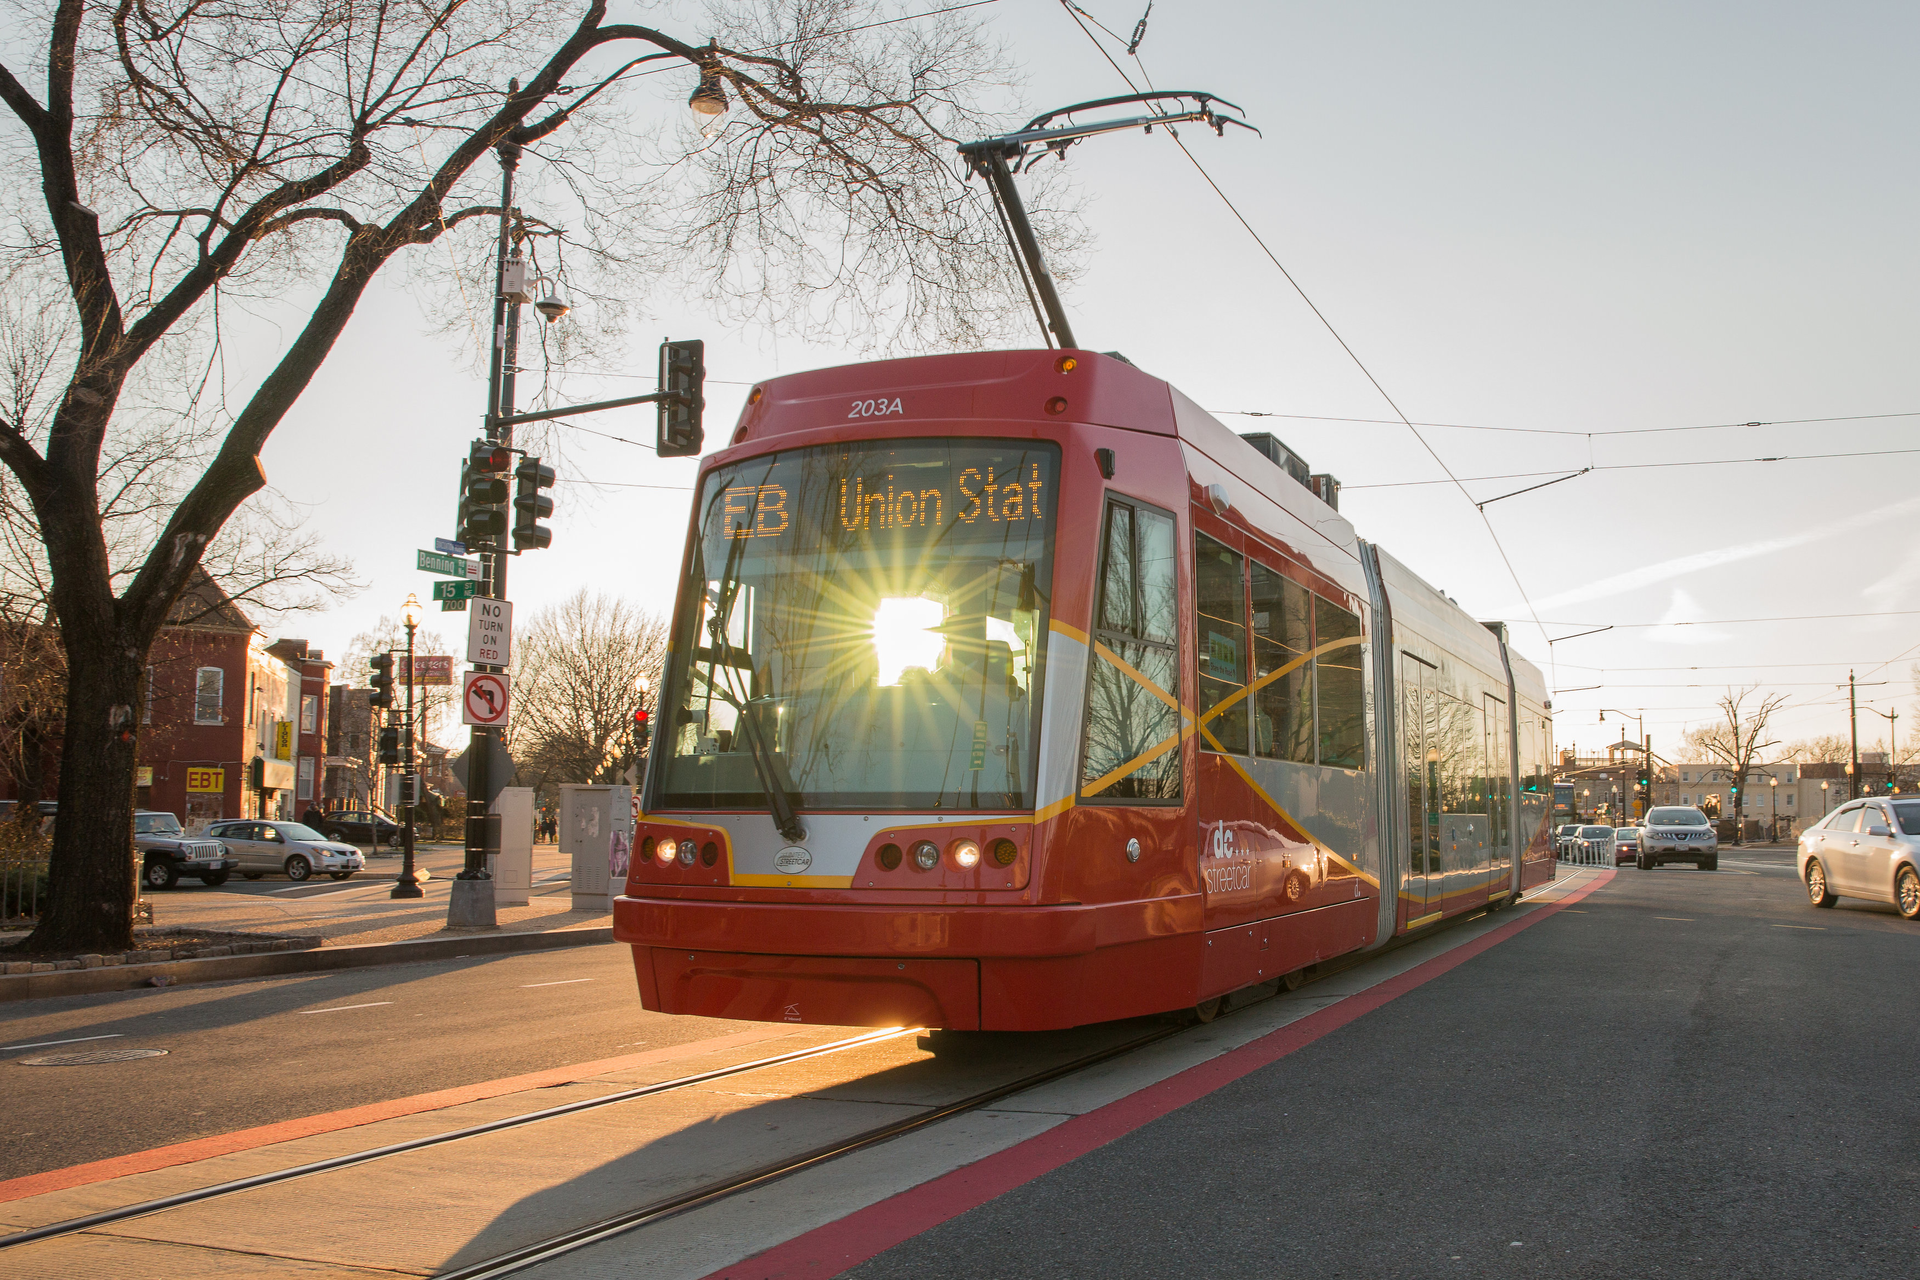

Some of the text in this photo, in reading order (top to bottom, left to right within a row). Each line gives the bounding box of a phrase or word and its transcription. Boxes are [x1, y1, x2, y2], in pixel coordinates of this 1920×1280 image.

[848, 397, 903, 418] 203A
[724, 463, 1043, 539] EB Union Stat
[420, 552, 455, 576] Benning
[441, 583, 456, 598] 15
[445, 601, 464, 610] 700
[482, 604, 501, 618] NO
[479, 620, 503, 632] TURN
[483, 635, 497, 645] ON
[480, 649, 498, 660] RED
[188, 772, 222, 788] EBT
[1213, 820, 1234, 859] dc
[1206, 861, 1251, 894] streetcar
